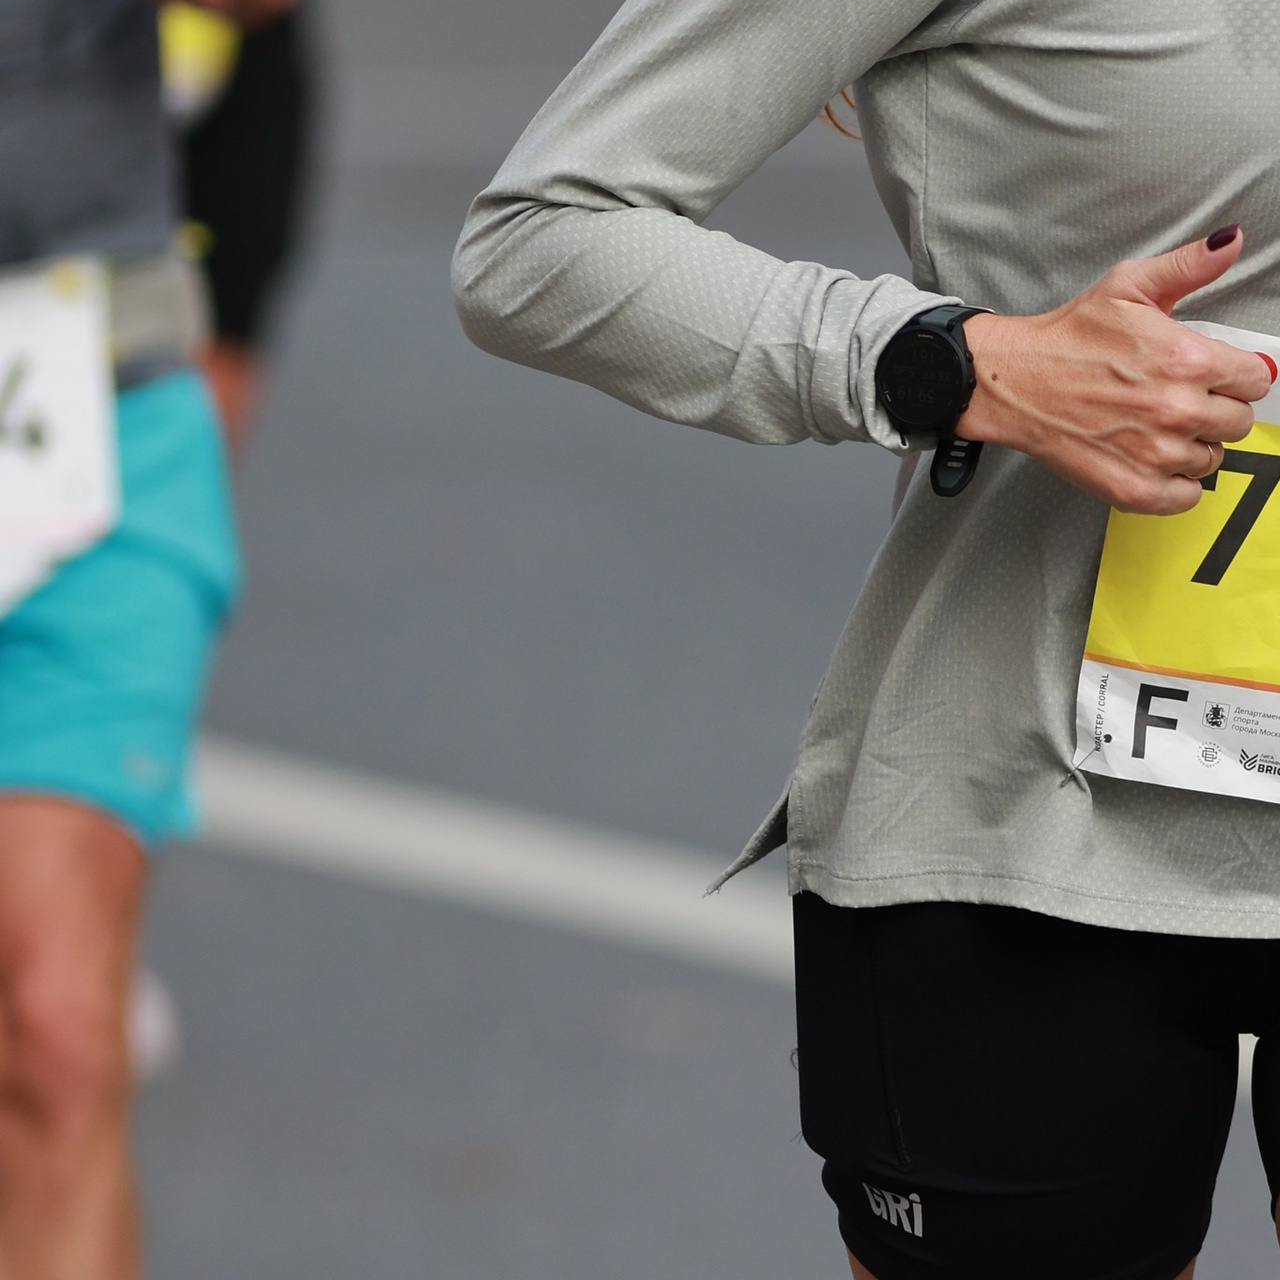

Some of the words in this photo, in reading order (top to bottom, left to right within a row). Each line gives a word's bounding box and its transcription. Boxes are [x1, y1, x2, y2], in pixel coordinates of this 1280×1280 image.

[1098, 673, 1110, 707] CORRAL
[1131, 683, 1190, 760] F
[1232, 723, 1259, 735] города
[1233, 715, 1260, 727] спорта
